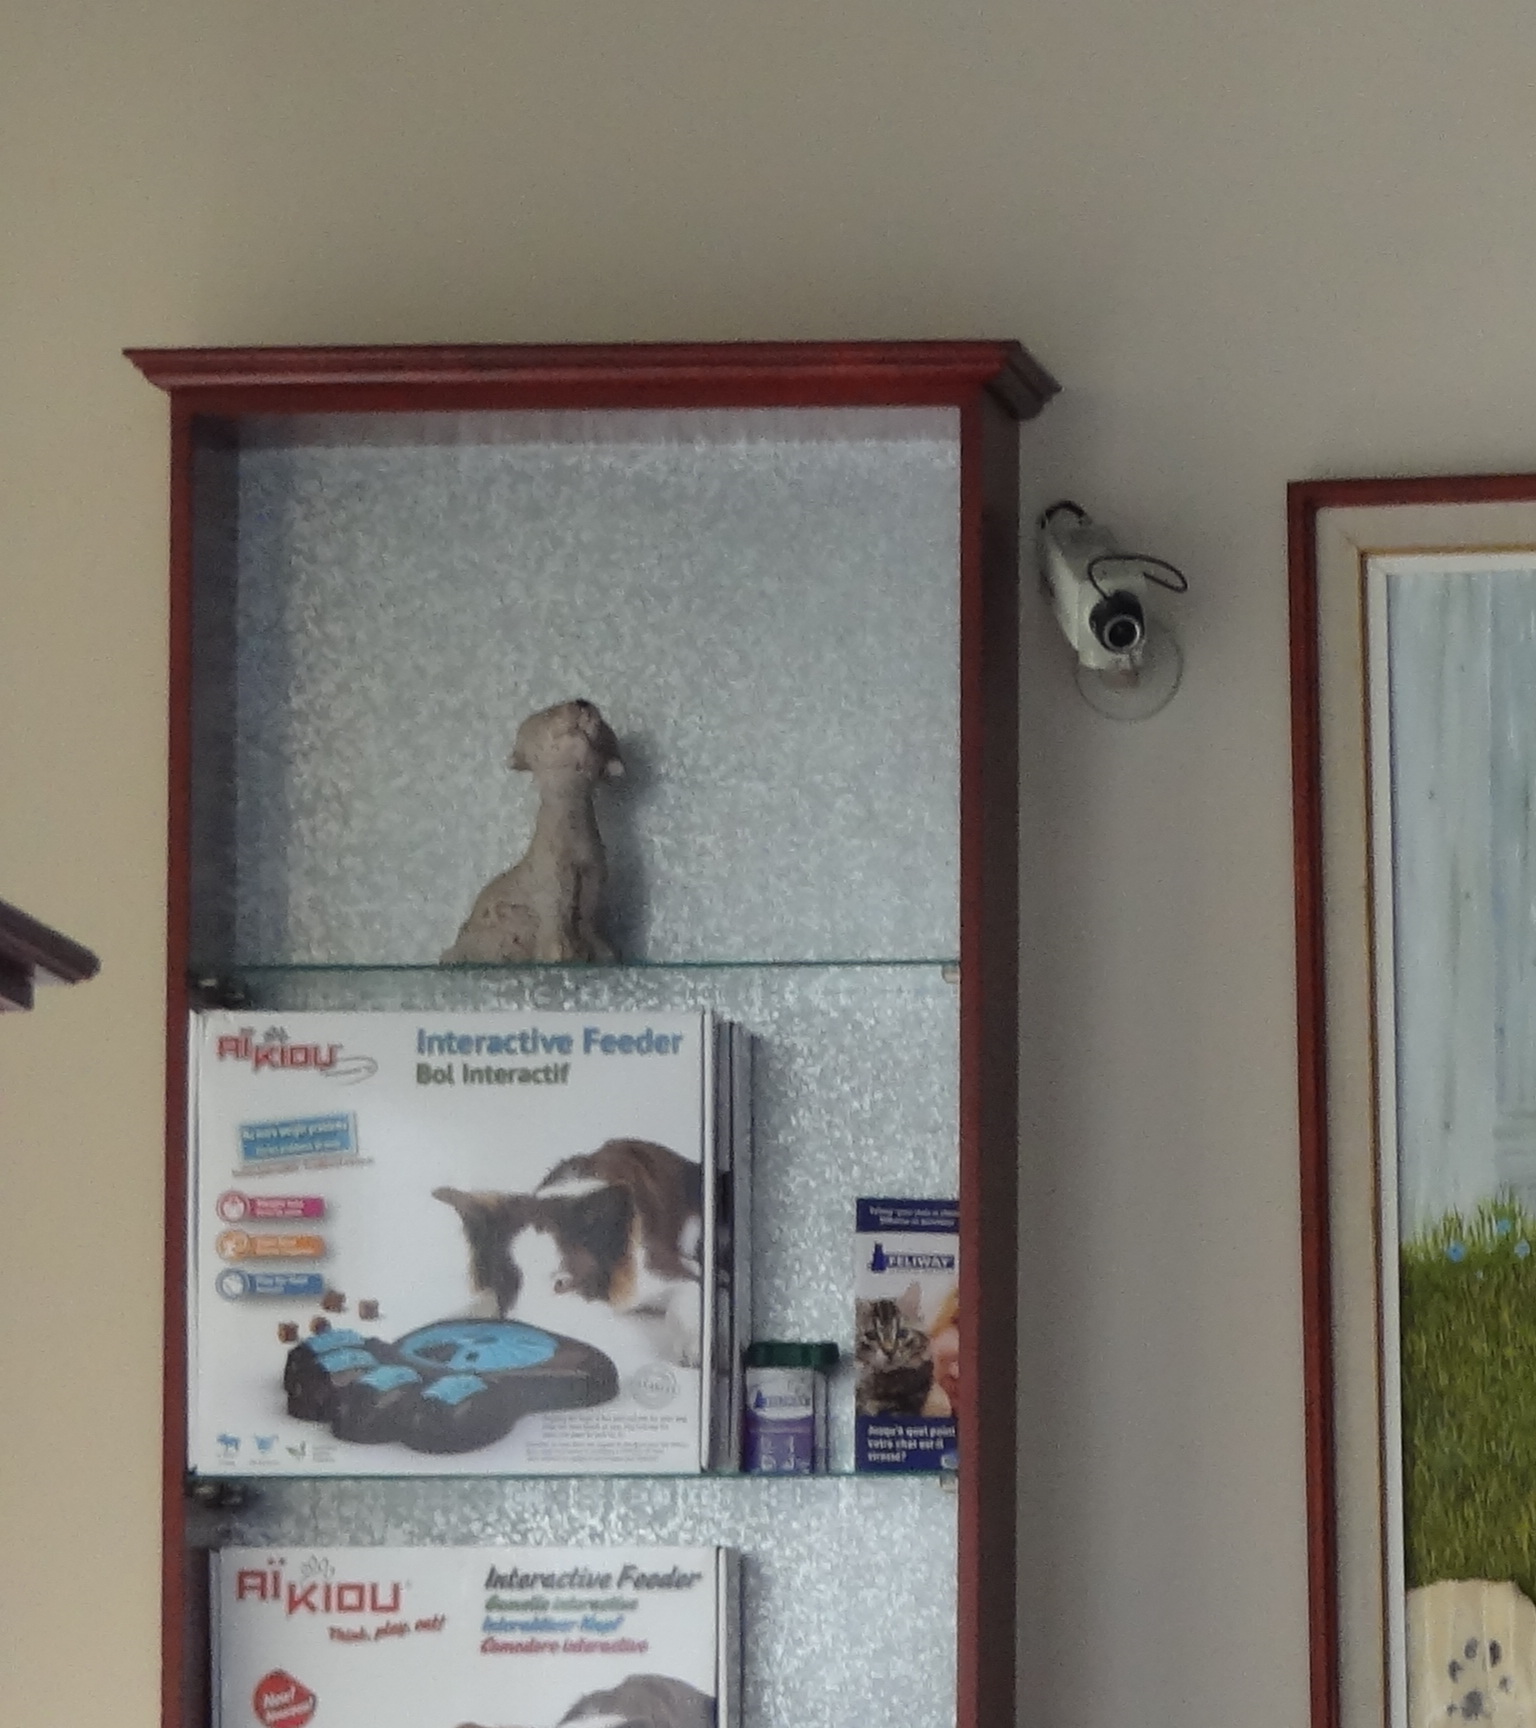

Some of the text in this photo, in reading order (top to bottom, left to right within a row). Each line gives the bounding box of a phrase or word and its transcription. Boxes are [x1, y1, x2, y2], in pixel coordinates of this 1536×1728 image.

[416, 1026, 683, 1055] Interactive Feeder
[416, 1062, 571, 1085] Bol Interactif
[887, 1255, 952, 1269] FELIWAY
[484, 1562, 703, 1591] Interactive Feeder
